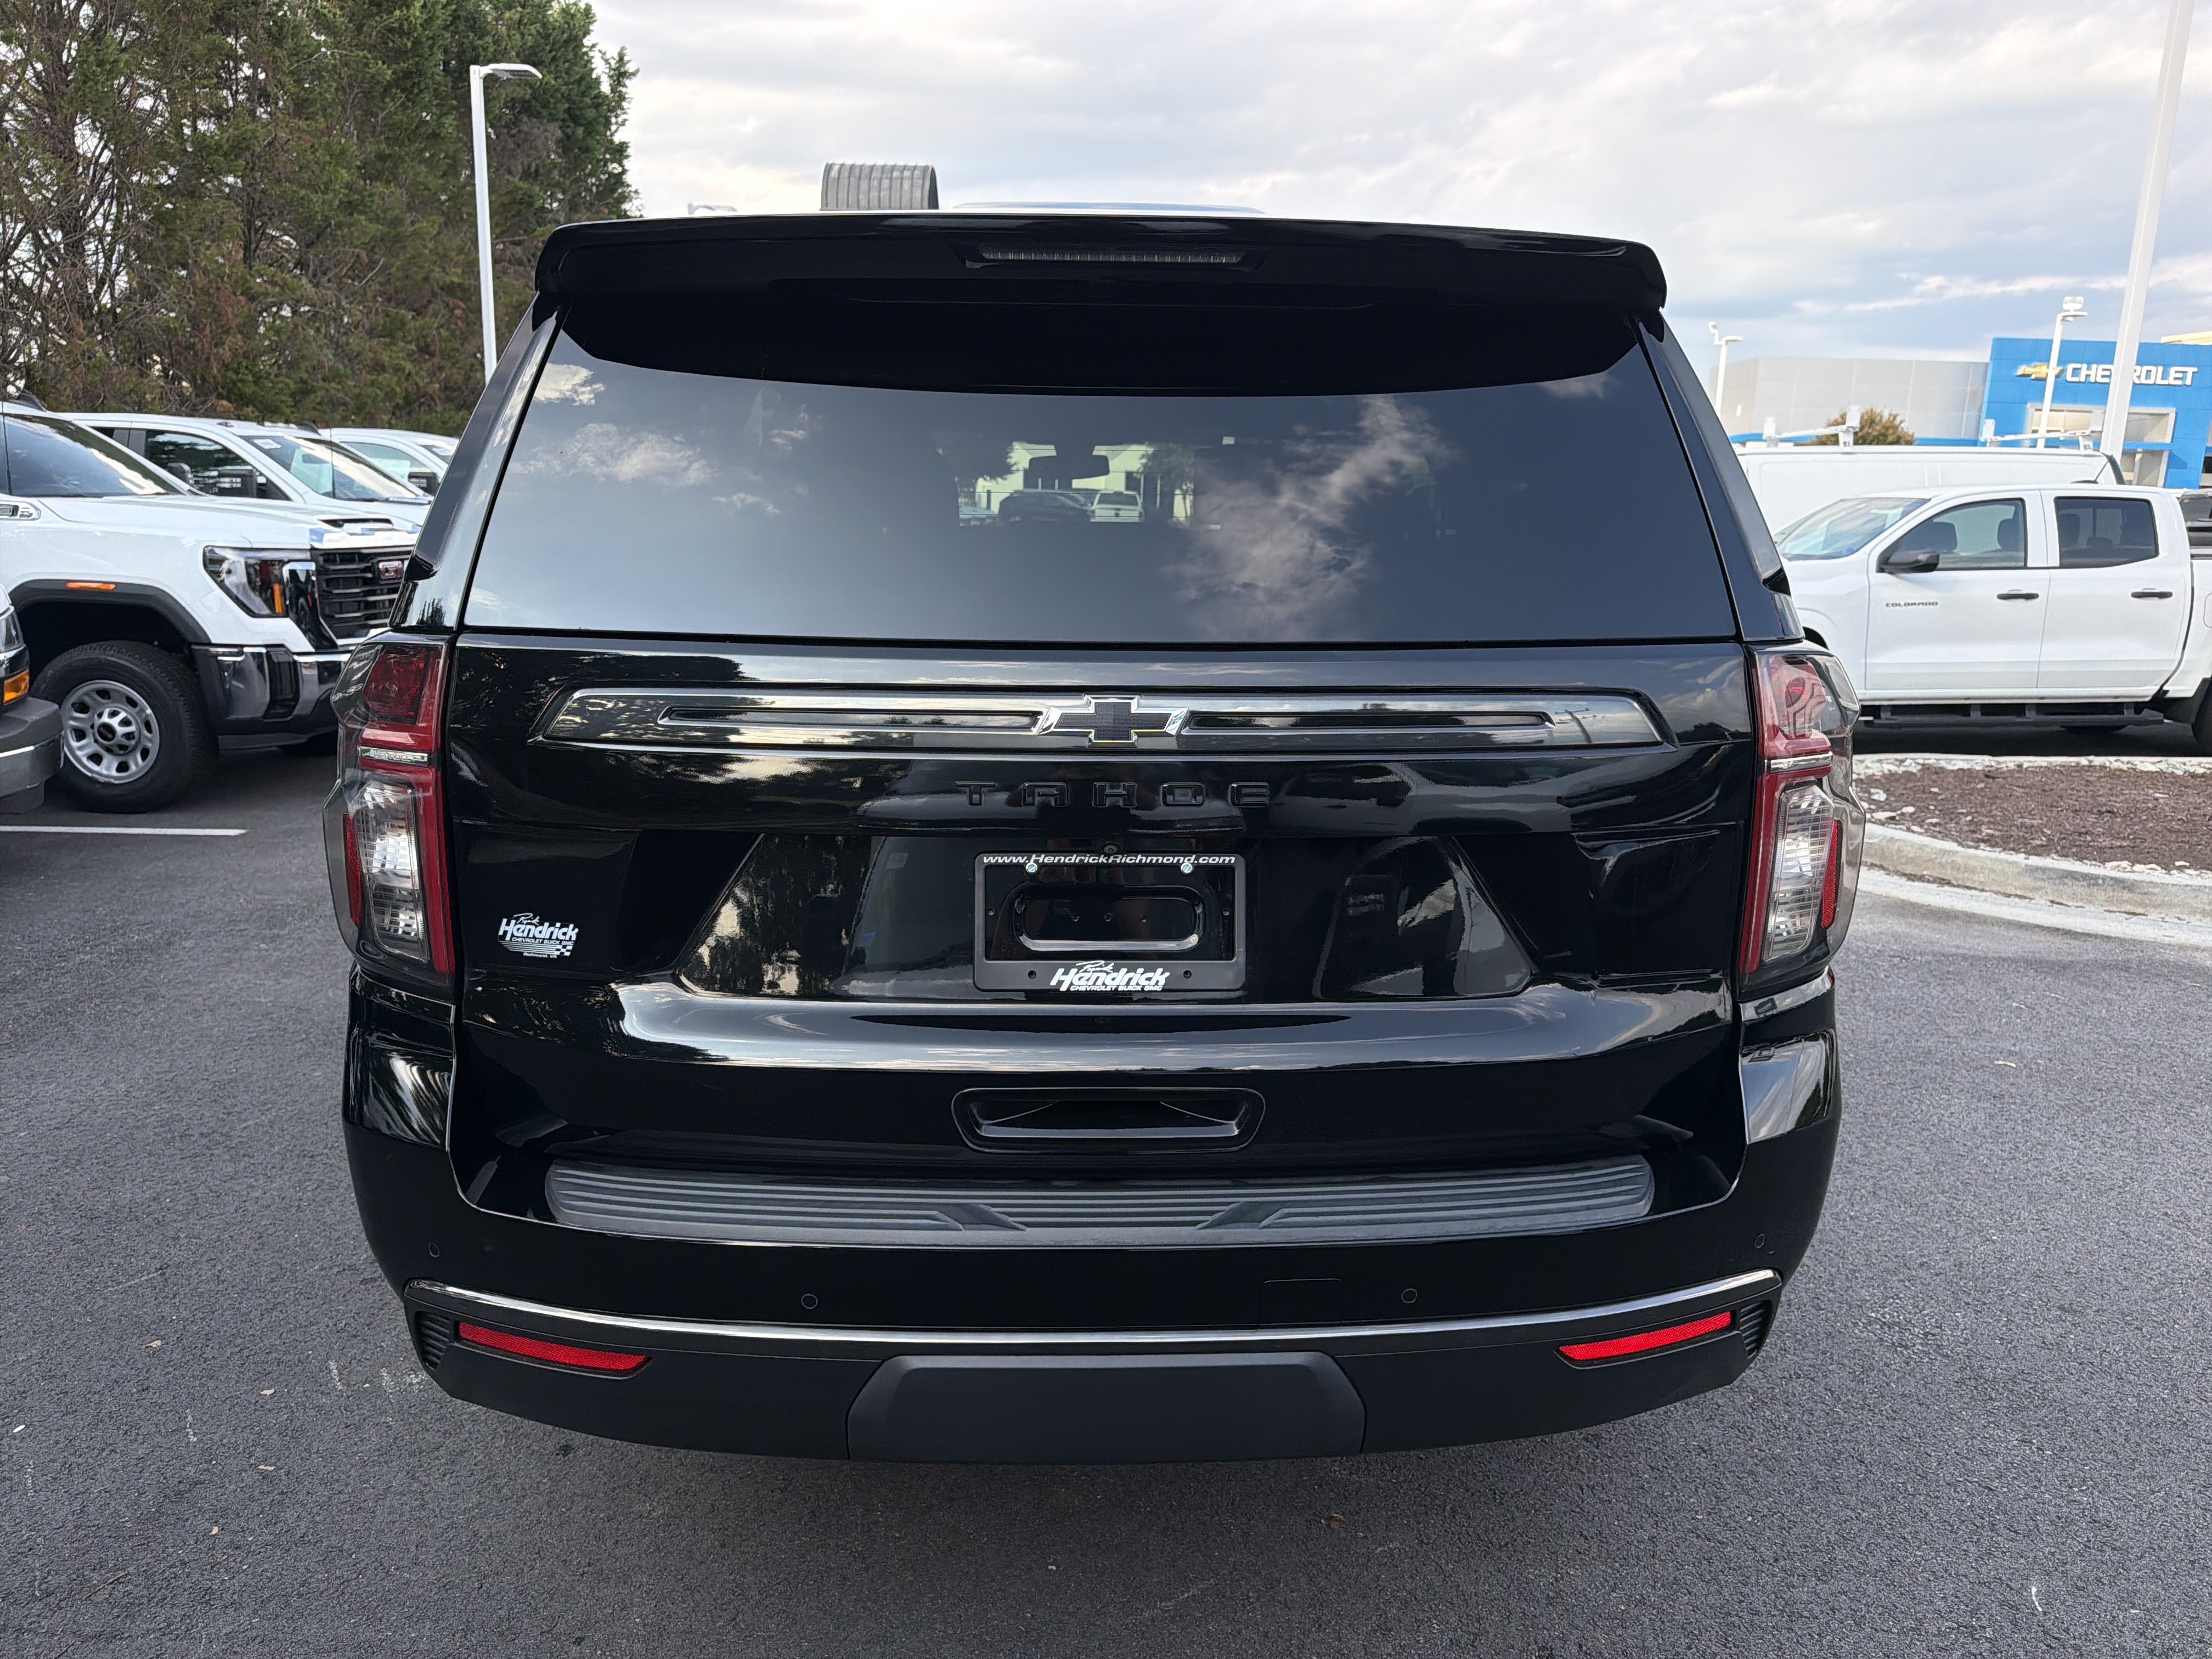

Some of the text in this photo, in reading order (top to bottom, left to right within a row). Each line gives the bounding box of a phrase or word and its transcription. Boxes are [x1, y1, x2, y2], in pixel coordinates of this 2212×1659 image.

[2066, 364, 2198, 385] CHEROLET
[955, 781, 1269, 808] TAHOE
[983, 854, 1235, 864] www.HendrickRichmond.com
[498, 918, 579, 941] Hendrick
[1049, 968, 1170, 991] Hendrick
